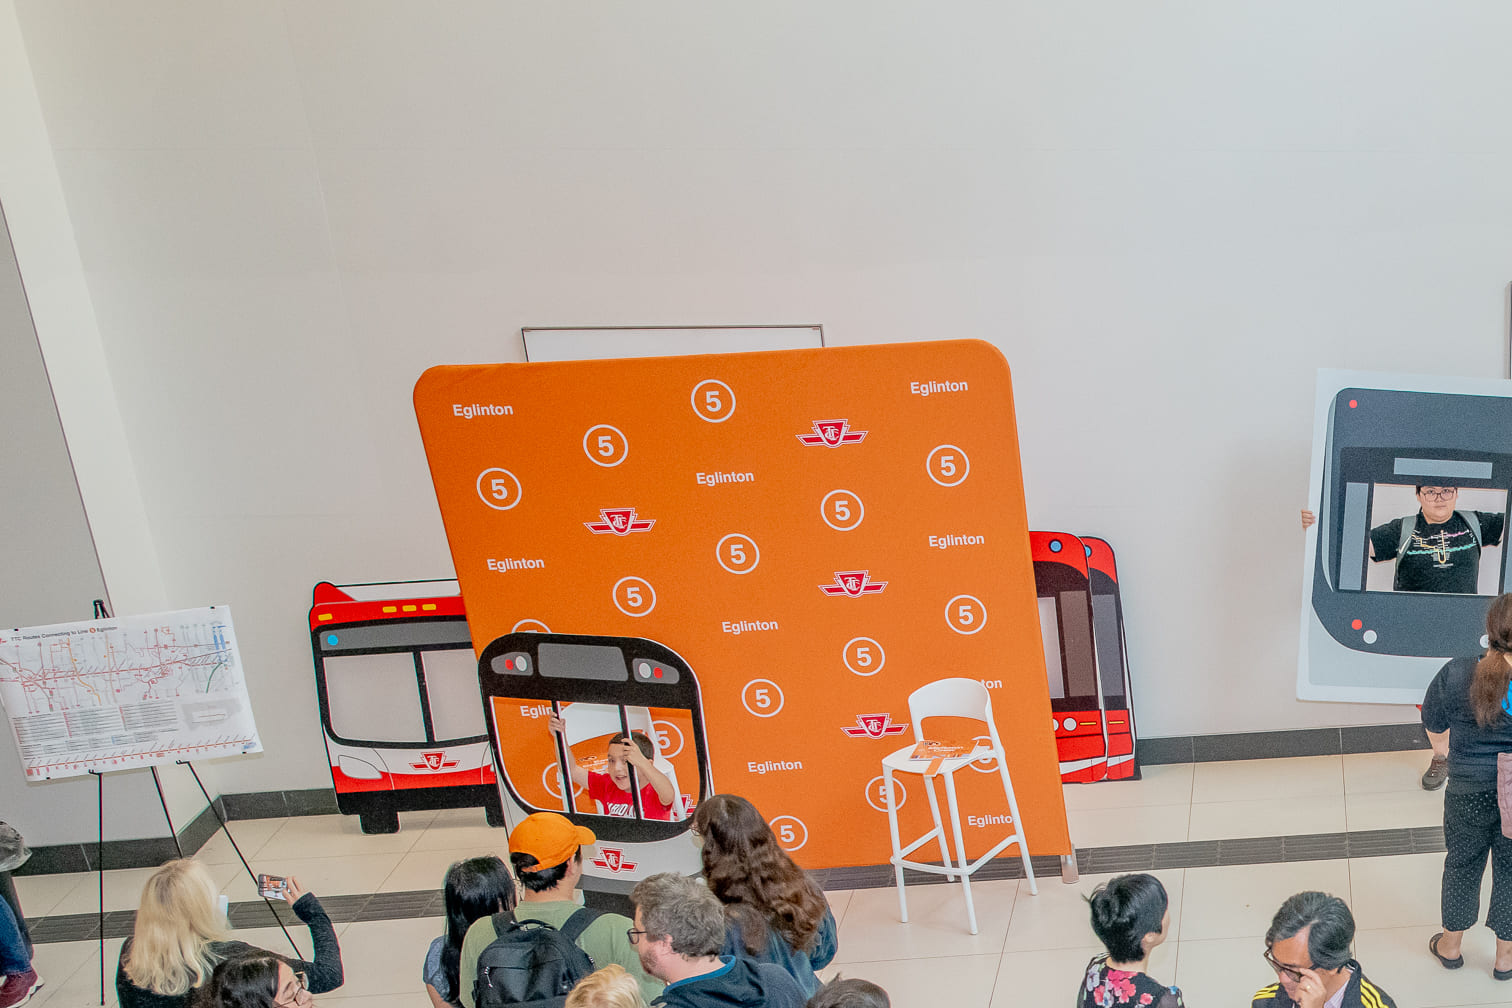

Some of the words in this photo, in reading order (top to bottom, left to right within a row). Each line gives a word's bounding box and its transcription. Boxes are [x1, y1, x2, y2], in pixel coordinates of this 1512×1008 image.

[911, 381, 968, 396] Eglinton
[706, 391, 721, 411] 5
[453, 404, 513, 419] Eglinton
[599, 436, 614, 456] 5
[941, 456, 955, 476] 5
[697, 472, 754, 486] Eglinton
[492, 479, 507, 499] 5
[836, 501, 850, 520] 5
[929, 535, 984, 549] Eglinton
[731, 545, 745, 564] 5
[487, 559, 544, 572] Eglinton
[627, 587, 642, 606] 5
[959, 606, 973, 624] 5
[722, 621, 778, 634] Eglinton
[857, 648, 871, 666] 5
[756, 689, 770, 707] 5
[748, 761, 802, 774] Eglinton
[968, 815, 1014, 828] Eglinto
[781, 825, 795, 842] 5
